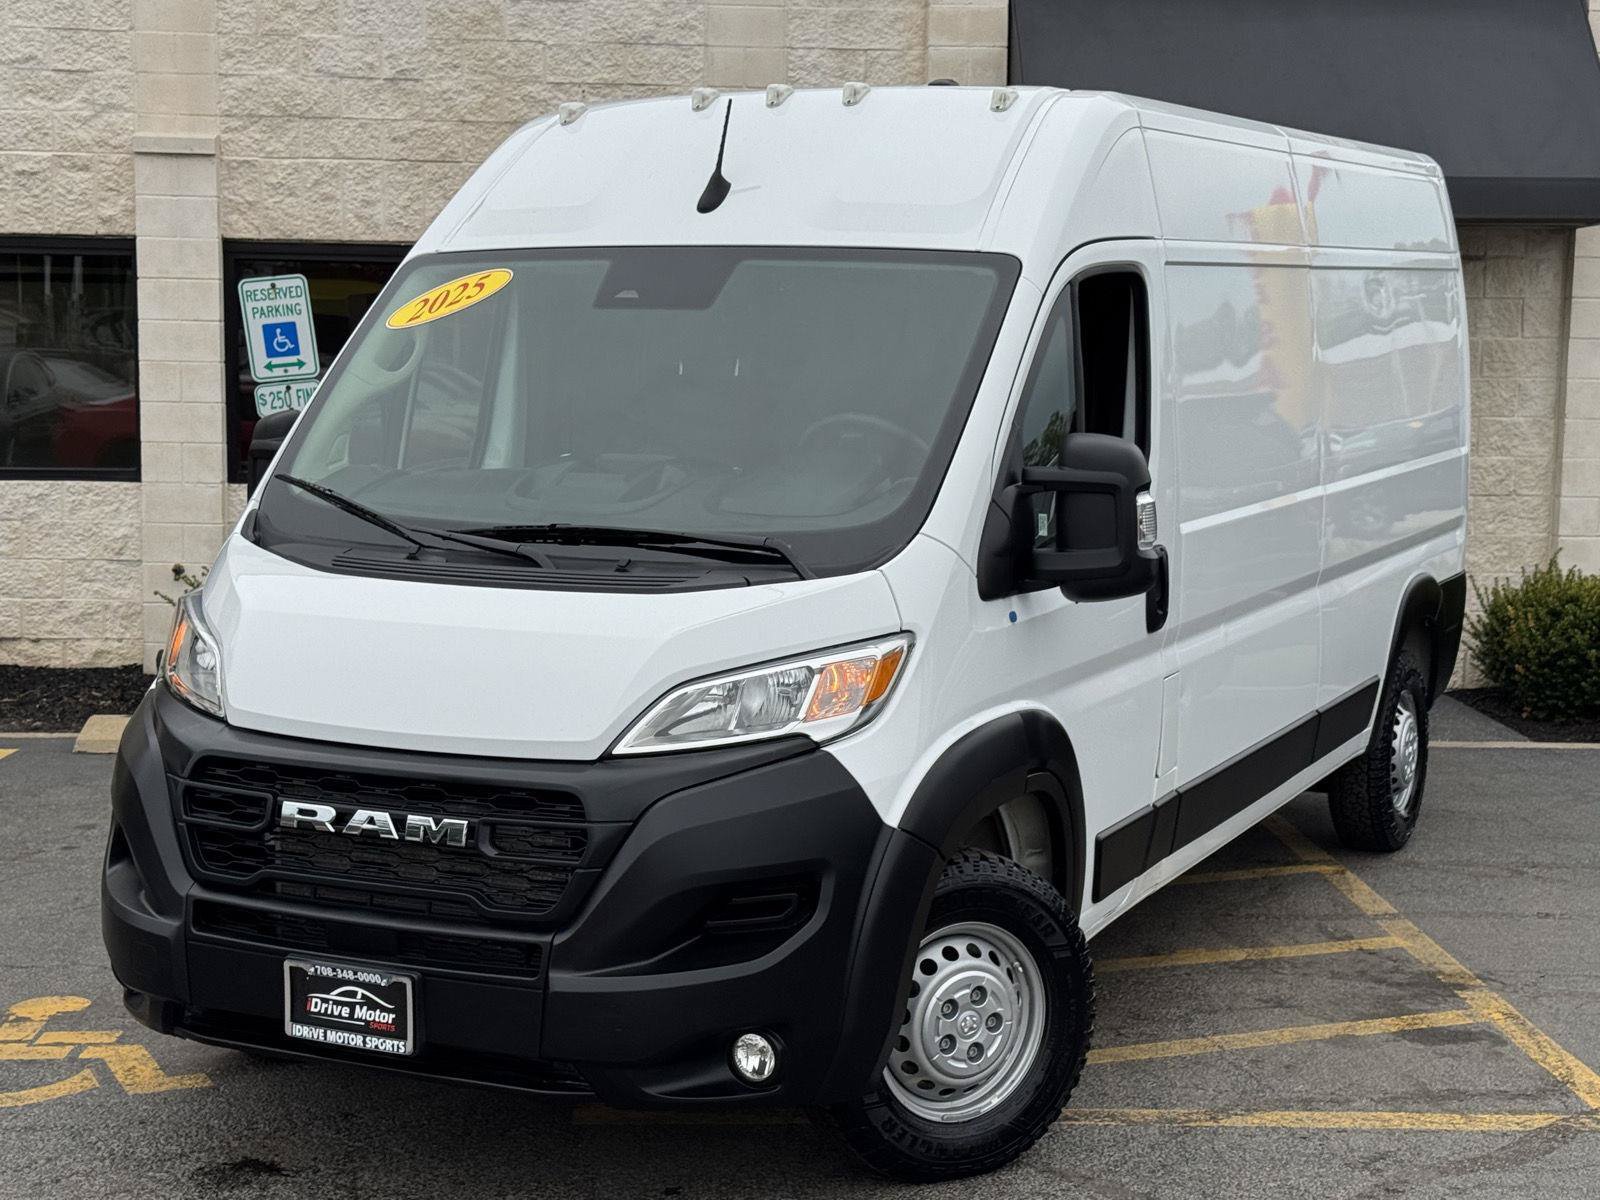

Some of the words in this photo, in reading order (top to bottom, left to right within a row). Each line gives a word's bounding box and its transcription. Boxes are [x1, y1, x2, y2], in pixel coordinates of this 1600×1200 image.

[245, 285, 303, 303] RESERVED
[406, 273, 492, 324] 2025
[251, 302, 302, 319] PARKING
[296, 386, 317, 407] FIN
[280, 800, 469, 848] RAM
[315, 965, 381, 984] 708-348-0000
[306, 997, 350, 1018] iDrive
[354, 1004, 396, 1024] Motor
[369, 1021, 396, 1032] SPORTS
[326, 1029, 364, 1047] MOTOR
[365, 1036, 406, 1053] SPORTS
